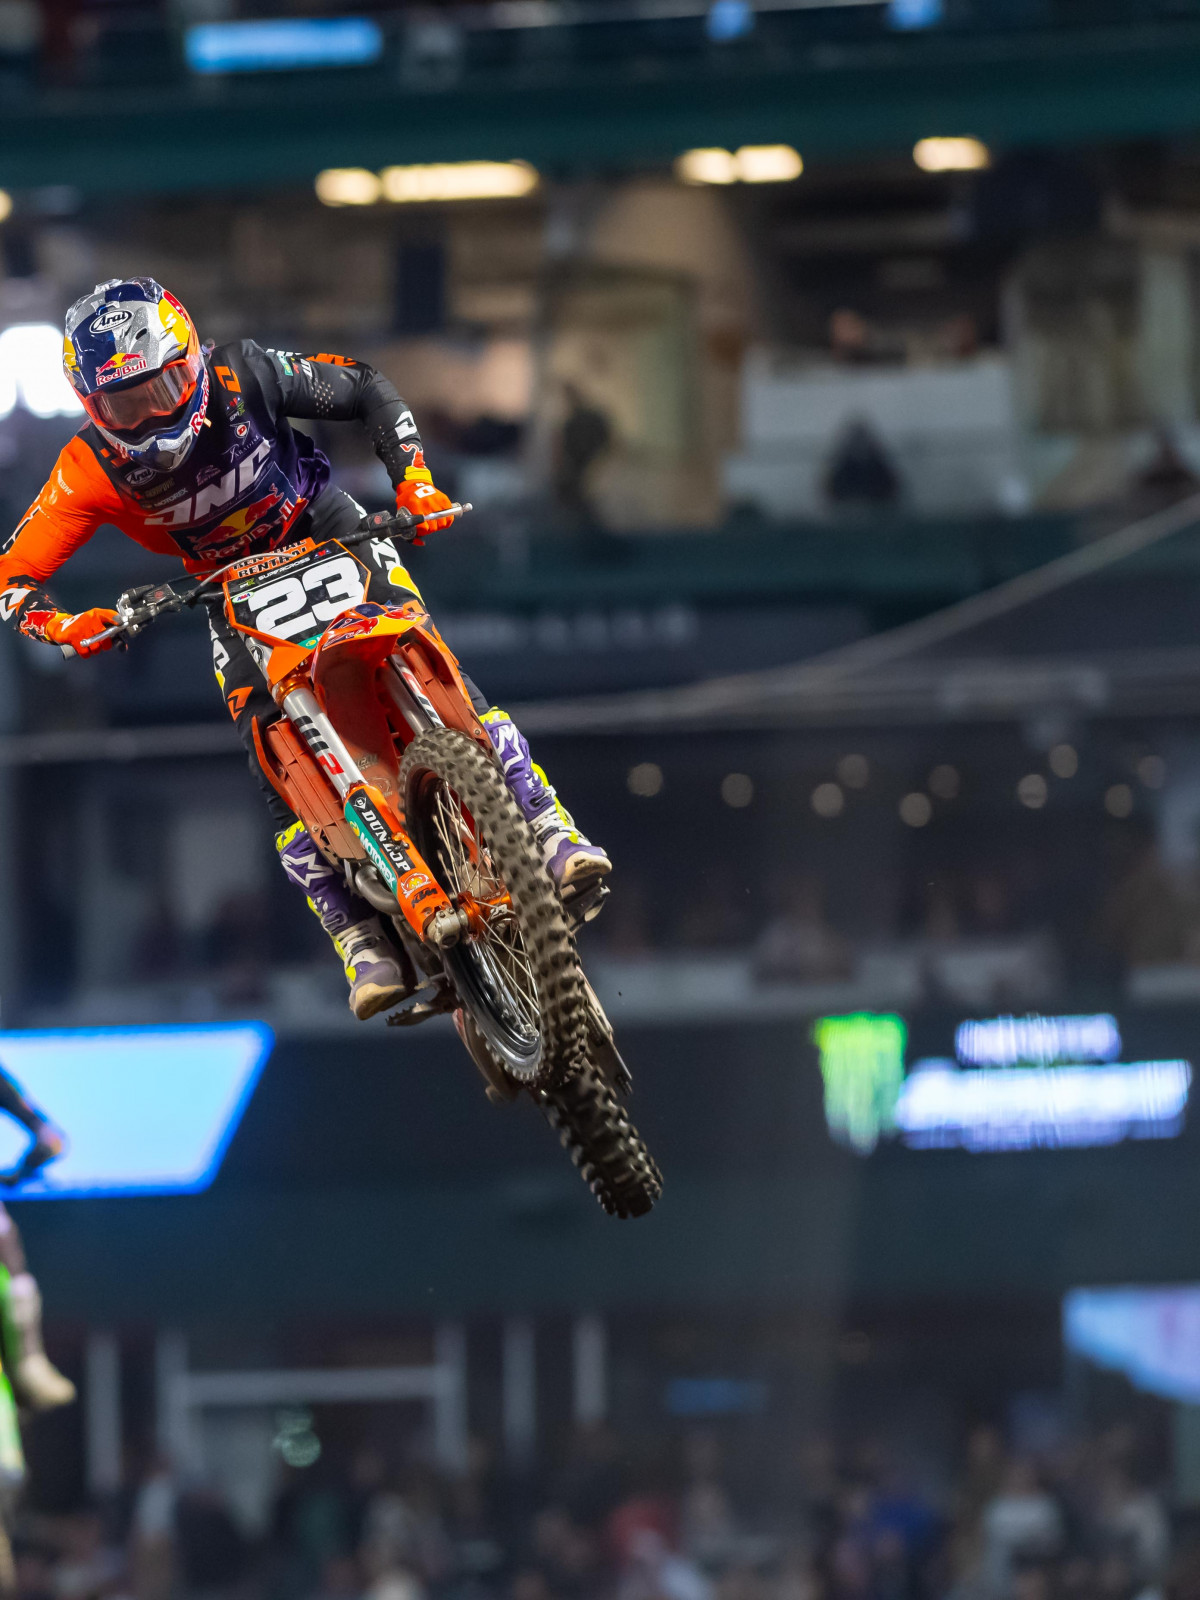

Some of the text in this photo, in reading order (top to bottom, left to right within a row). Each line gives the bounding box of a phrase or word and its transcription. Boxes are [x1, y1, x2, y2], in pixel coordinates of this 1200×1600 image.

[96, 360, 147, 387] Red Bull
[197, 534, 253, 561] Red
[248, 557, 365, 640] 23
[360, 832, 397, 888] MOTOREX
[362, 810, 411, 872] DUNLOP
[411, 888, 439, 908] KTM
